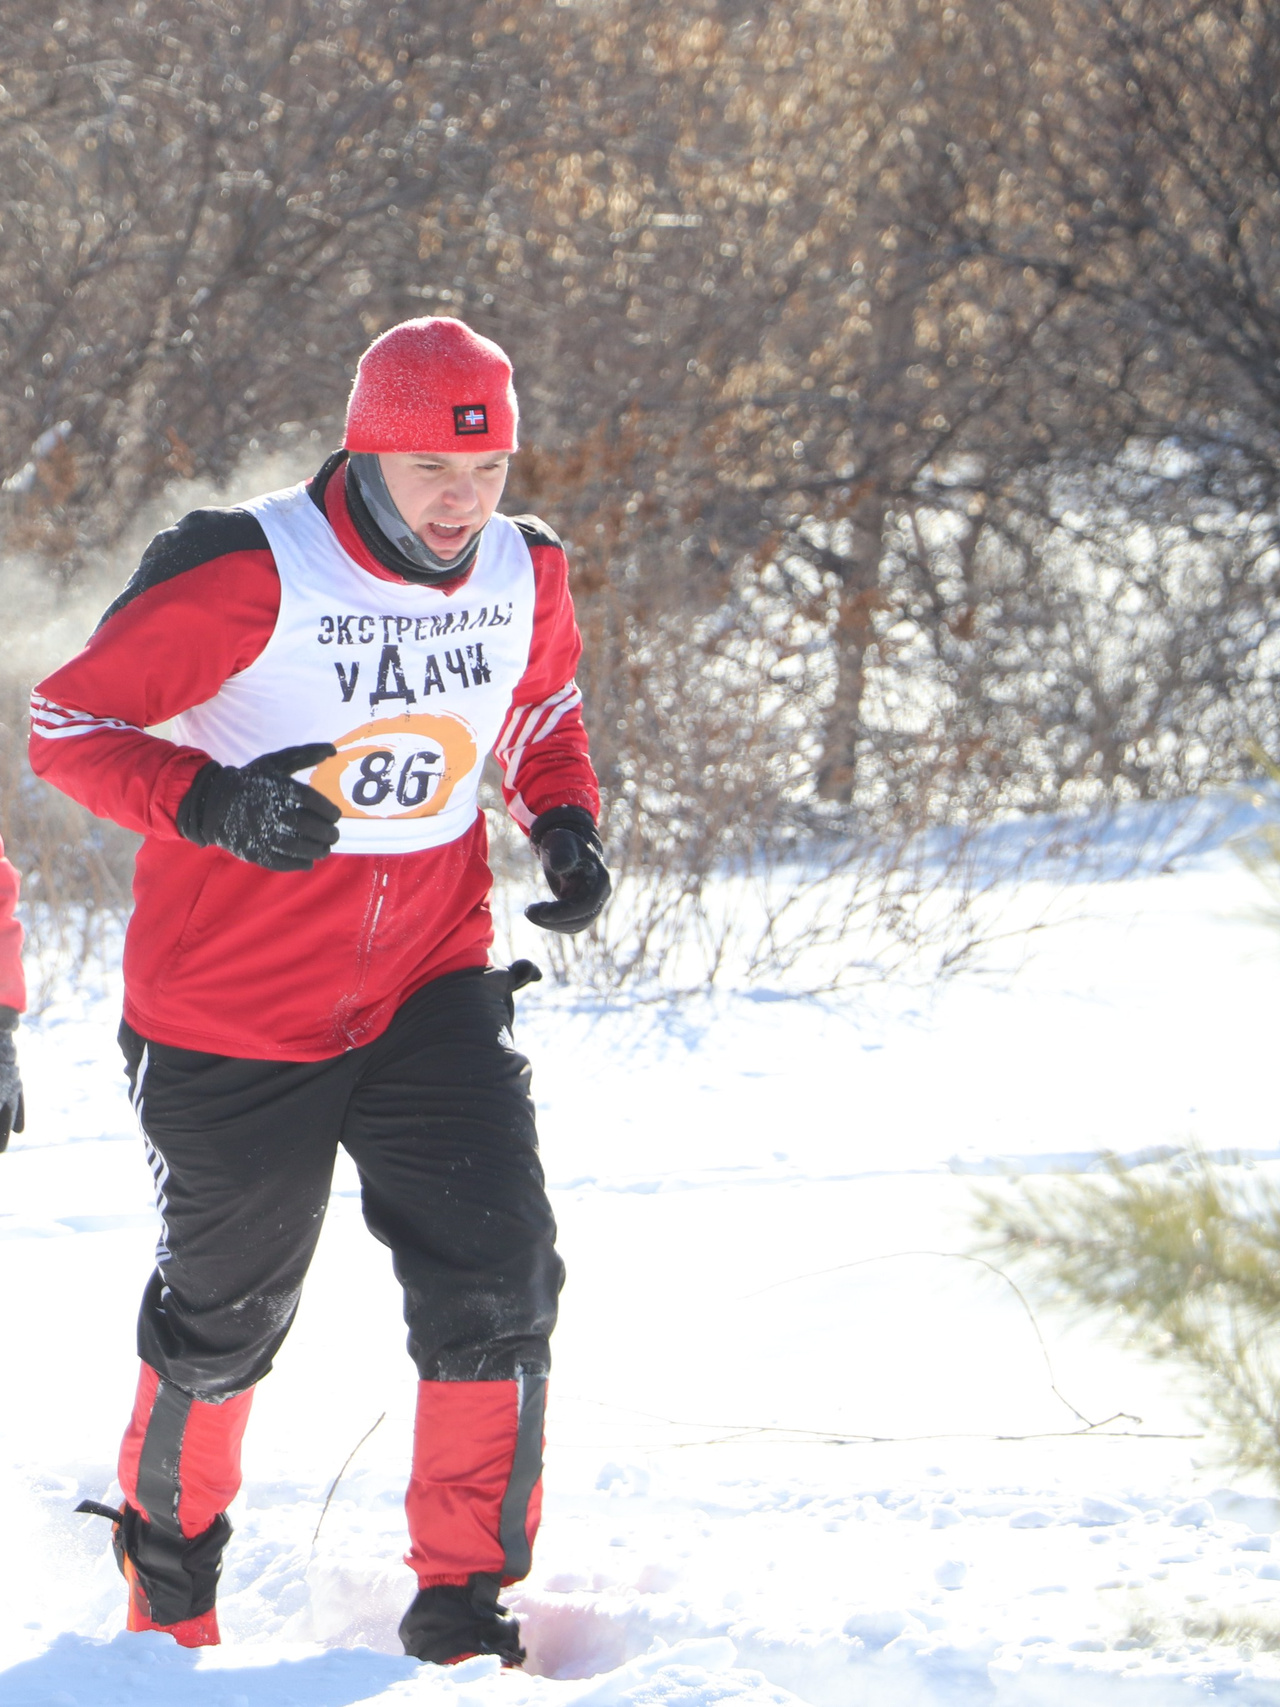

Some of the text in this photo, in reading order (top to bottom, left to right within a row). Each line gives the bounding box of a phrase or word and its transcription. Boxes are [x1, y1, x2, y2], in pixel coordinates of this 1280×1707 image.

[317, 602, 513, 645] ЭКСТРЕМАЛЫ
[334, 642, 492, 706] УДАЧИ
[352, 751, 441, 807] 86
